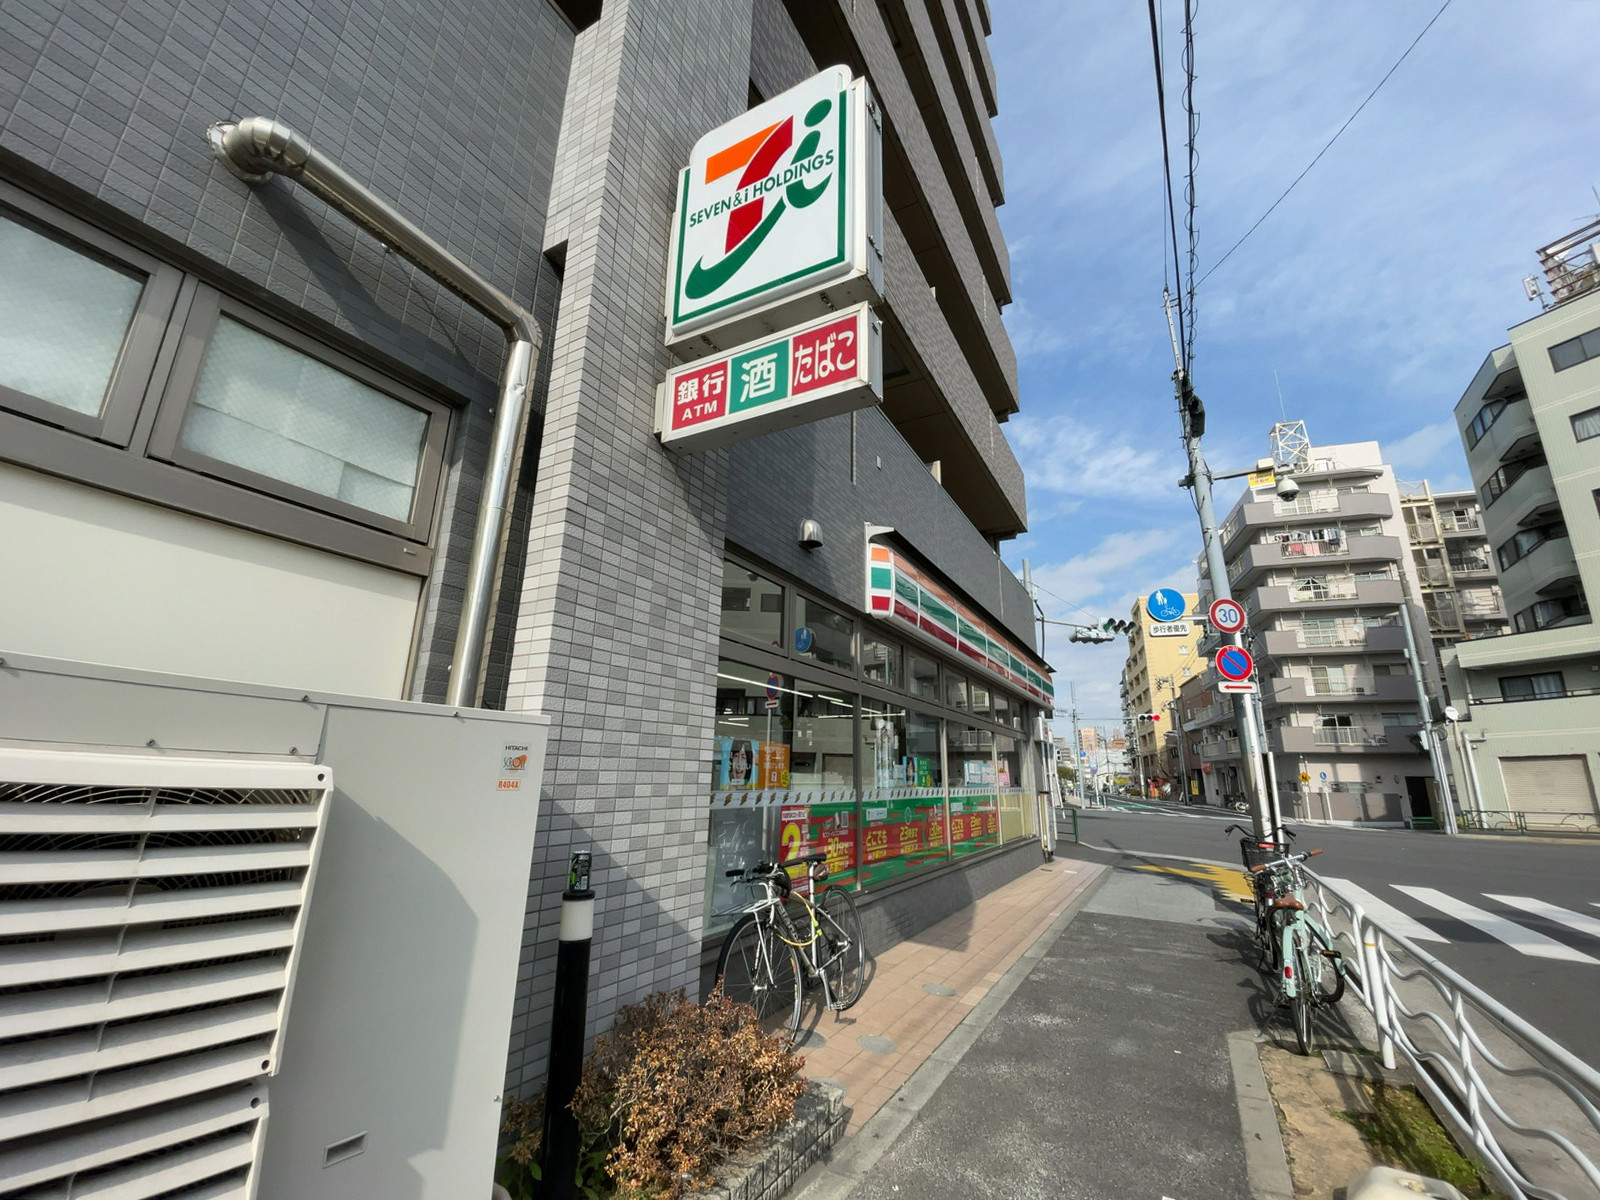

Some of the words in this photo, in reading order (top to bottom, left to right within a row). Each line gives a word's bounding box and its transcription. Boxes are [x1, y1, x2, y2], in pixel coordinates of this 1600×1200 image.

[753, 149, 834, 199] HOLDINGS
[794, 331, 856, 386] たばこ
[677, 369, 725, 405] 銀行
[740, 353, 778, 403] 酒
[681, 400, 717, 421] ATM
[1152, 624, 1188, 633] 歩行者優先
[1218, 608, 1238, 624] 30
[498, 781, 518, 789] R404A
